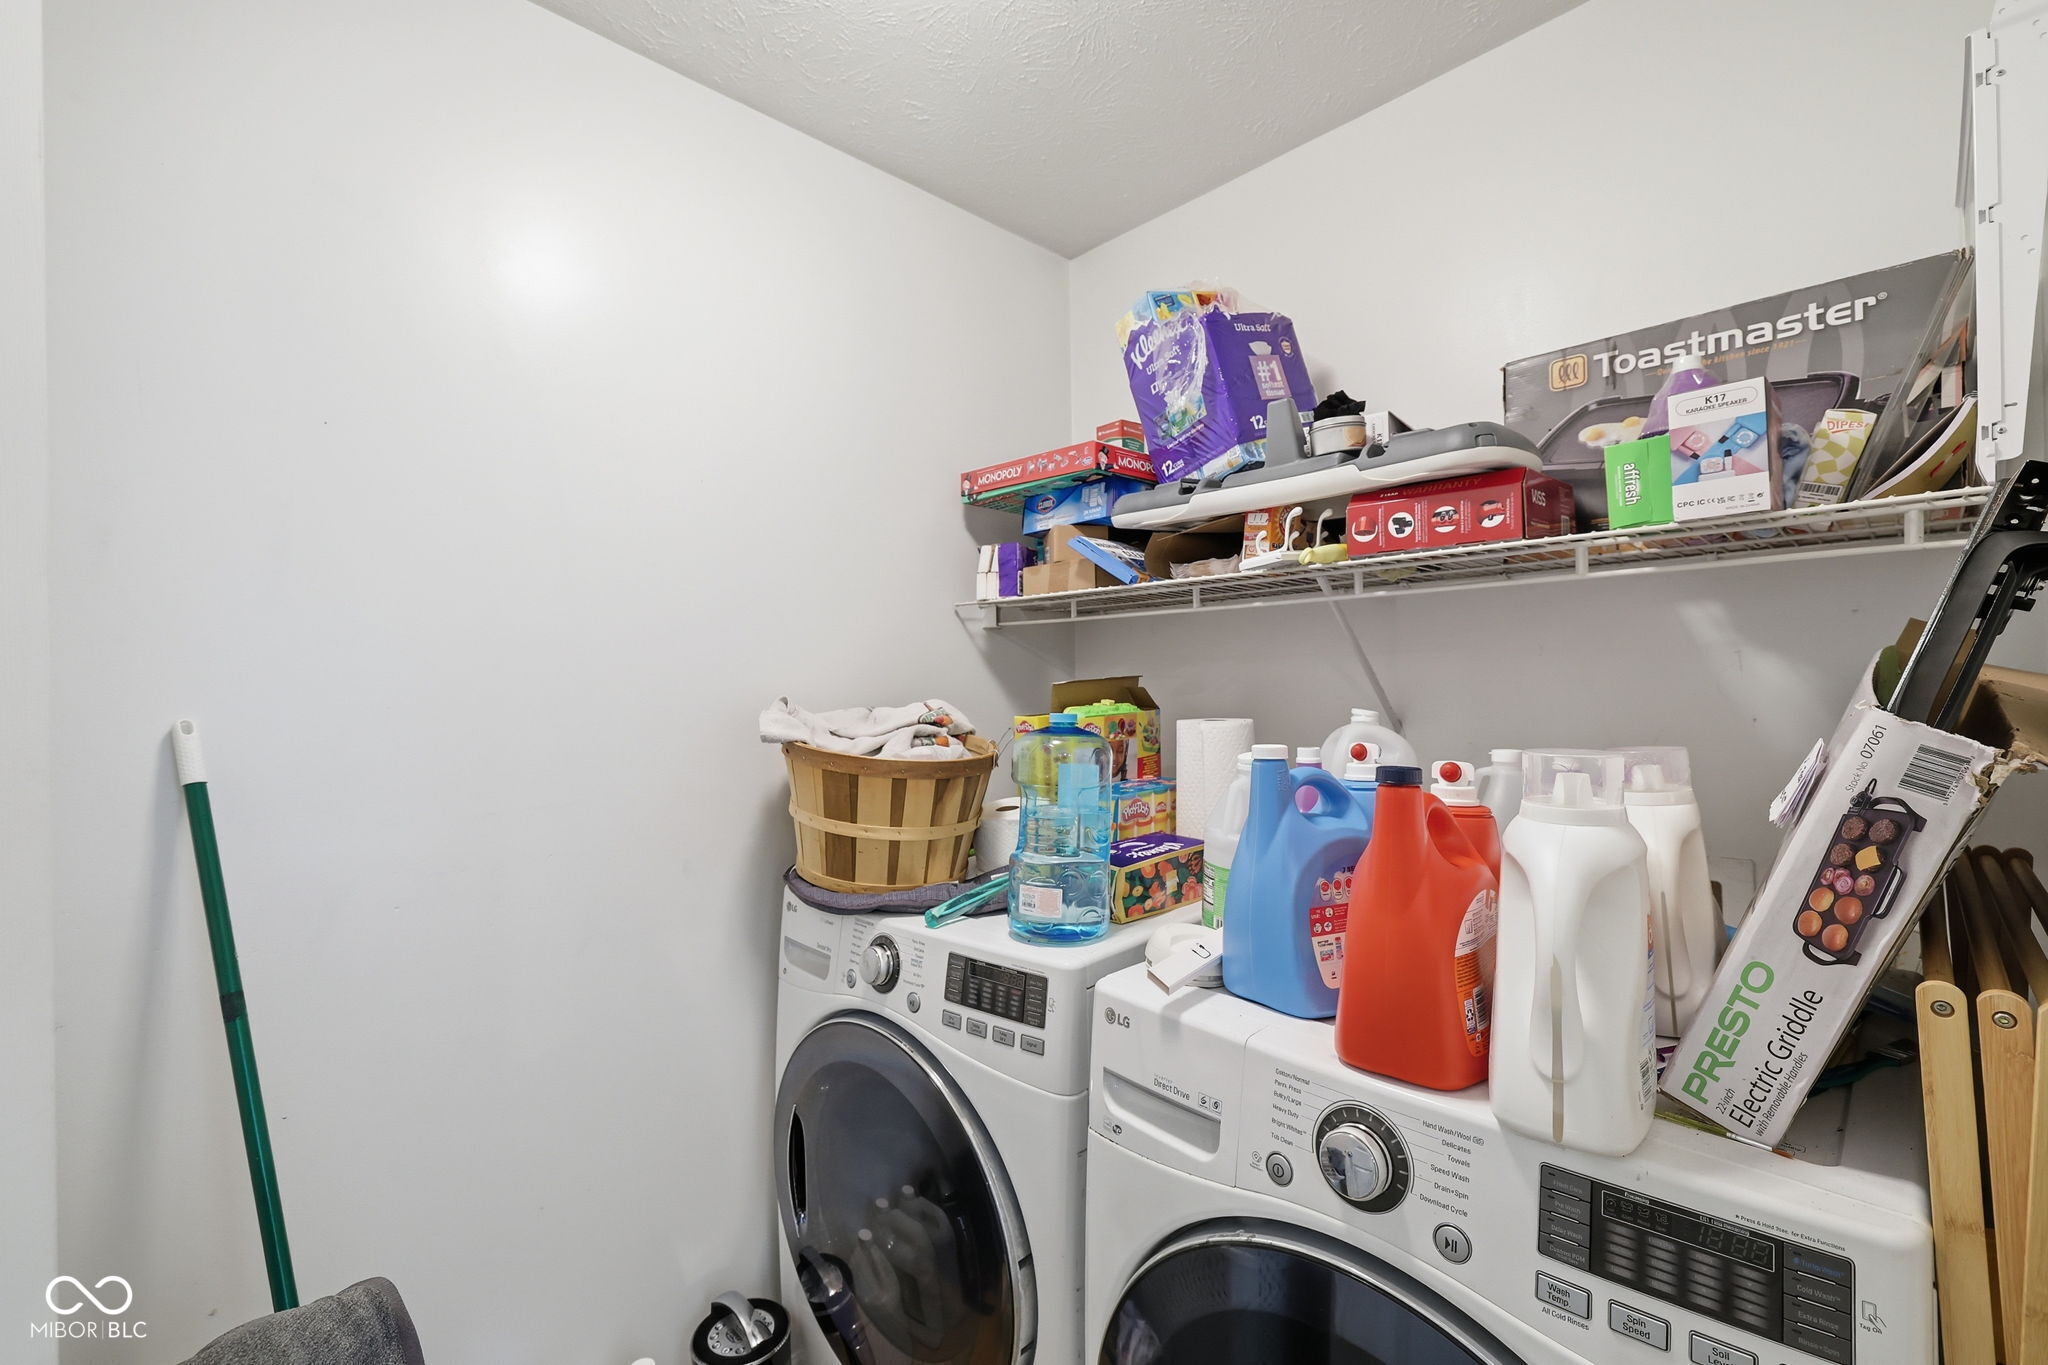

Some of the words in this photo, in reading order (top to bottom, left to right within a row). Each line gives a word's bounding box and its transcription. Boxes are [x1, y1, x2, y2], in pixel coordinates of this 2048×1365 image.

[1234, 323, 1256, 332] Ultra
[1255, 323, 1271, 332] Soft
[1257, 360, 1282, 381] #1
[1685, 403, 1717, 415] KARAOKE
[1717, 397, 1748, 408] SPEAKER
[1704, 393, 1727, 405] K17
[1250, 414, 1265, 430] 12
[977, 465, 1022, 486] MONOPOLY
[1161, 460, 1174, 477] 12
[1403, 477, 1482, 496] WARRANTY
[1623, 463, 1642, 506] affresh
[1676, 500, 1695, 509] CPC
[1696, 498, 1706, 506] IC
[1845, 770, 1862, 793] Stock
[1860, 724, 1888, 760] 07061
[1116, 1013, 1131, 1029] LG
[1681, 960, 1775, 1105] PRESTO
[1728, 1060, 1784, 1129] Electric
[1766, 989, 1824, 1060] Griddle
[1275, 1067, 1311, 1086] Cotton/Normal
[1153, 1077, 1172, 1096] Direct
[1173, 1084, 1191, 1101] Drive
[1289, 1083, 1302, 1094] Press
[1755, 1112, 1769, 1137] with
[1763, 1081, 1792, 1122] Removable
[1786, 1051, 1809, 1087] Handles
[1273, 1090, 1302, 1107] Bulky/Large
[1715, 1087, 1736, 1116] 22-inch
[1272, 1103, 1287, 1117] Heavy
[1287, 1108, 1299, 1120] Duty
[1271, 1116, 1286, 1130] Bright
[1422, 1119, 1438, 1131] Hand
[1437, 1124, 1472, 1142] Wash/Wool
[1270, 1131, 1280, 1140] Tub
[1280, 1135, 1294, 1147] Clean
[1441, 1138, 1472, 1155] Delicates
[1447, 1153, 1471, 1169] Towels
[1430, 1163, 1451, 1177] Speed
[1451, 1170, 1471, 1184] Wash
[1419, 1192, 1451, 1212] Download
[1450, 1205, 1469, 1218] Cycle
[1566, 1227, 1583, 1241] Wash
[1740, 1214, 1756, 1225] Press
[1761, 1221, 1775, 1231] Hold
[1791, 1230, 1800, 1239] for
[1800, 1232, 1817, 1244] Extra
[1817, 1238, 1846, 1253] Functions
[1547, 1281, 1571, 1299] Wash
[1796, 1284, 1814, 1297] Cold
[1546, 1290, 1572, 1309] Temp.
[1541, 1306, 1551, 1315] All
[1551, 1309, 1567, 1323] Cold
[1567, 1314, 1590, 1332] Rinses
[1626, 1314, 1647, 1329] Spin
[1797, 1309, 1818, 1324] Extra
[1818, 1316, 1840, 1332] Rinse
[1622, 1322, 1651, 1341] Speed
[1859, 1322, 1872, 1335] Tag
[1711, 1346, 1731, 1361] Soil
